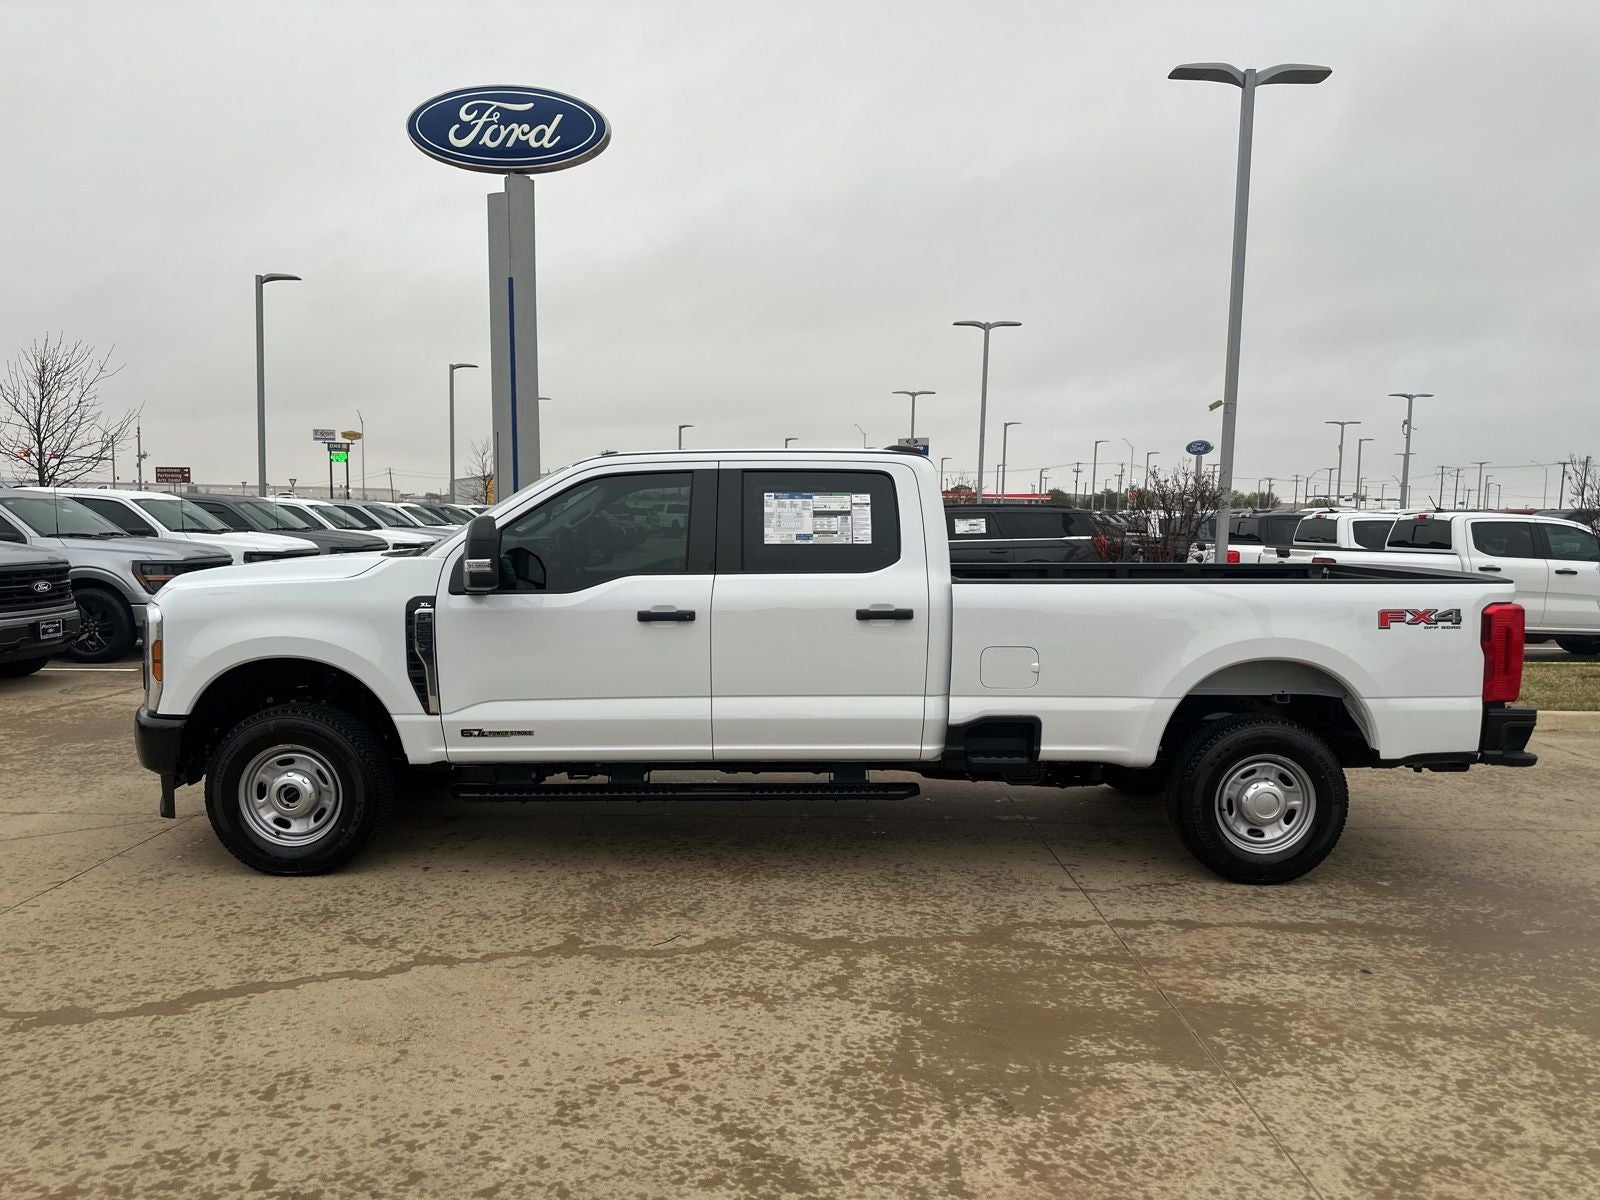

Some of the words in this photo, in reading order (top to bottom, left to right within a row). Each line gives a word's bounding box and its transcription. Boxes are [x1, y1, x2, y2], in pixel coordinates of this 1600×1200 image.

[449, 100, 563, 149] Ford
[314, 430, 335, 438] Exxon
[1378, 608, 1463, 630] FX4
